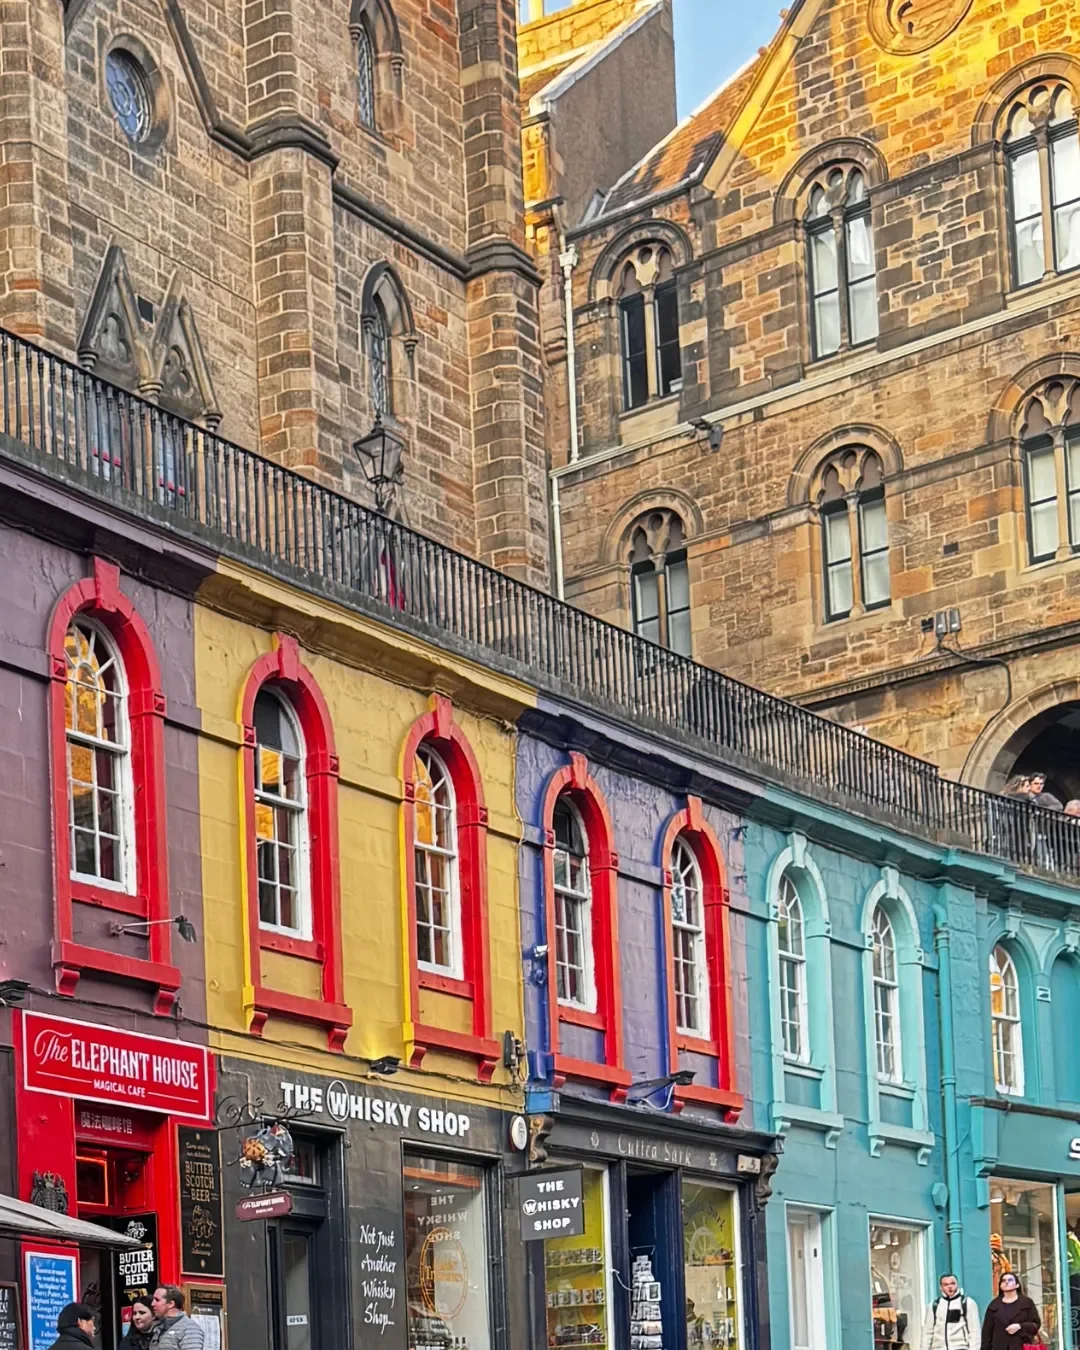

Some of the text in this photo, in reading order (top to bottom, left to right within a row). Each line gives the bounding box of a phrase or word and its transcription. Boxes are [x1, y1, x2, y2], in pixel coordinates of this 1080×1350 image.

[33, 1029, 199, 1090] The ELEPHANT HOUSE
[93, 1079, 146, 1098] MAGICAL CAFE
[280, 1082, 470, 1137] THE WHISKY SHOP
[664, 1142, 692, 1166] Sark
[185, 1161, 214, 1176] BUTTER
[185, 1175, 215, 1189] SCOTCH
[536, 1180, 565, 1193] THE
[190, 1189, 211, 1202] BEER
[522, 1197, 581, 1216] WHISKY
[533, 1217, 571, 1232] SHOP
[360, 1224, 376, 1245] Not
[119, 1249, 154, 1265] BUTTER
[361, 1253, 397, 1273] Another
[118, 1260, 155, 1275] SCOTCH
[125, 1272, 149, 1286] BEER
[362, 1278, 395, 1308] Whisky
